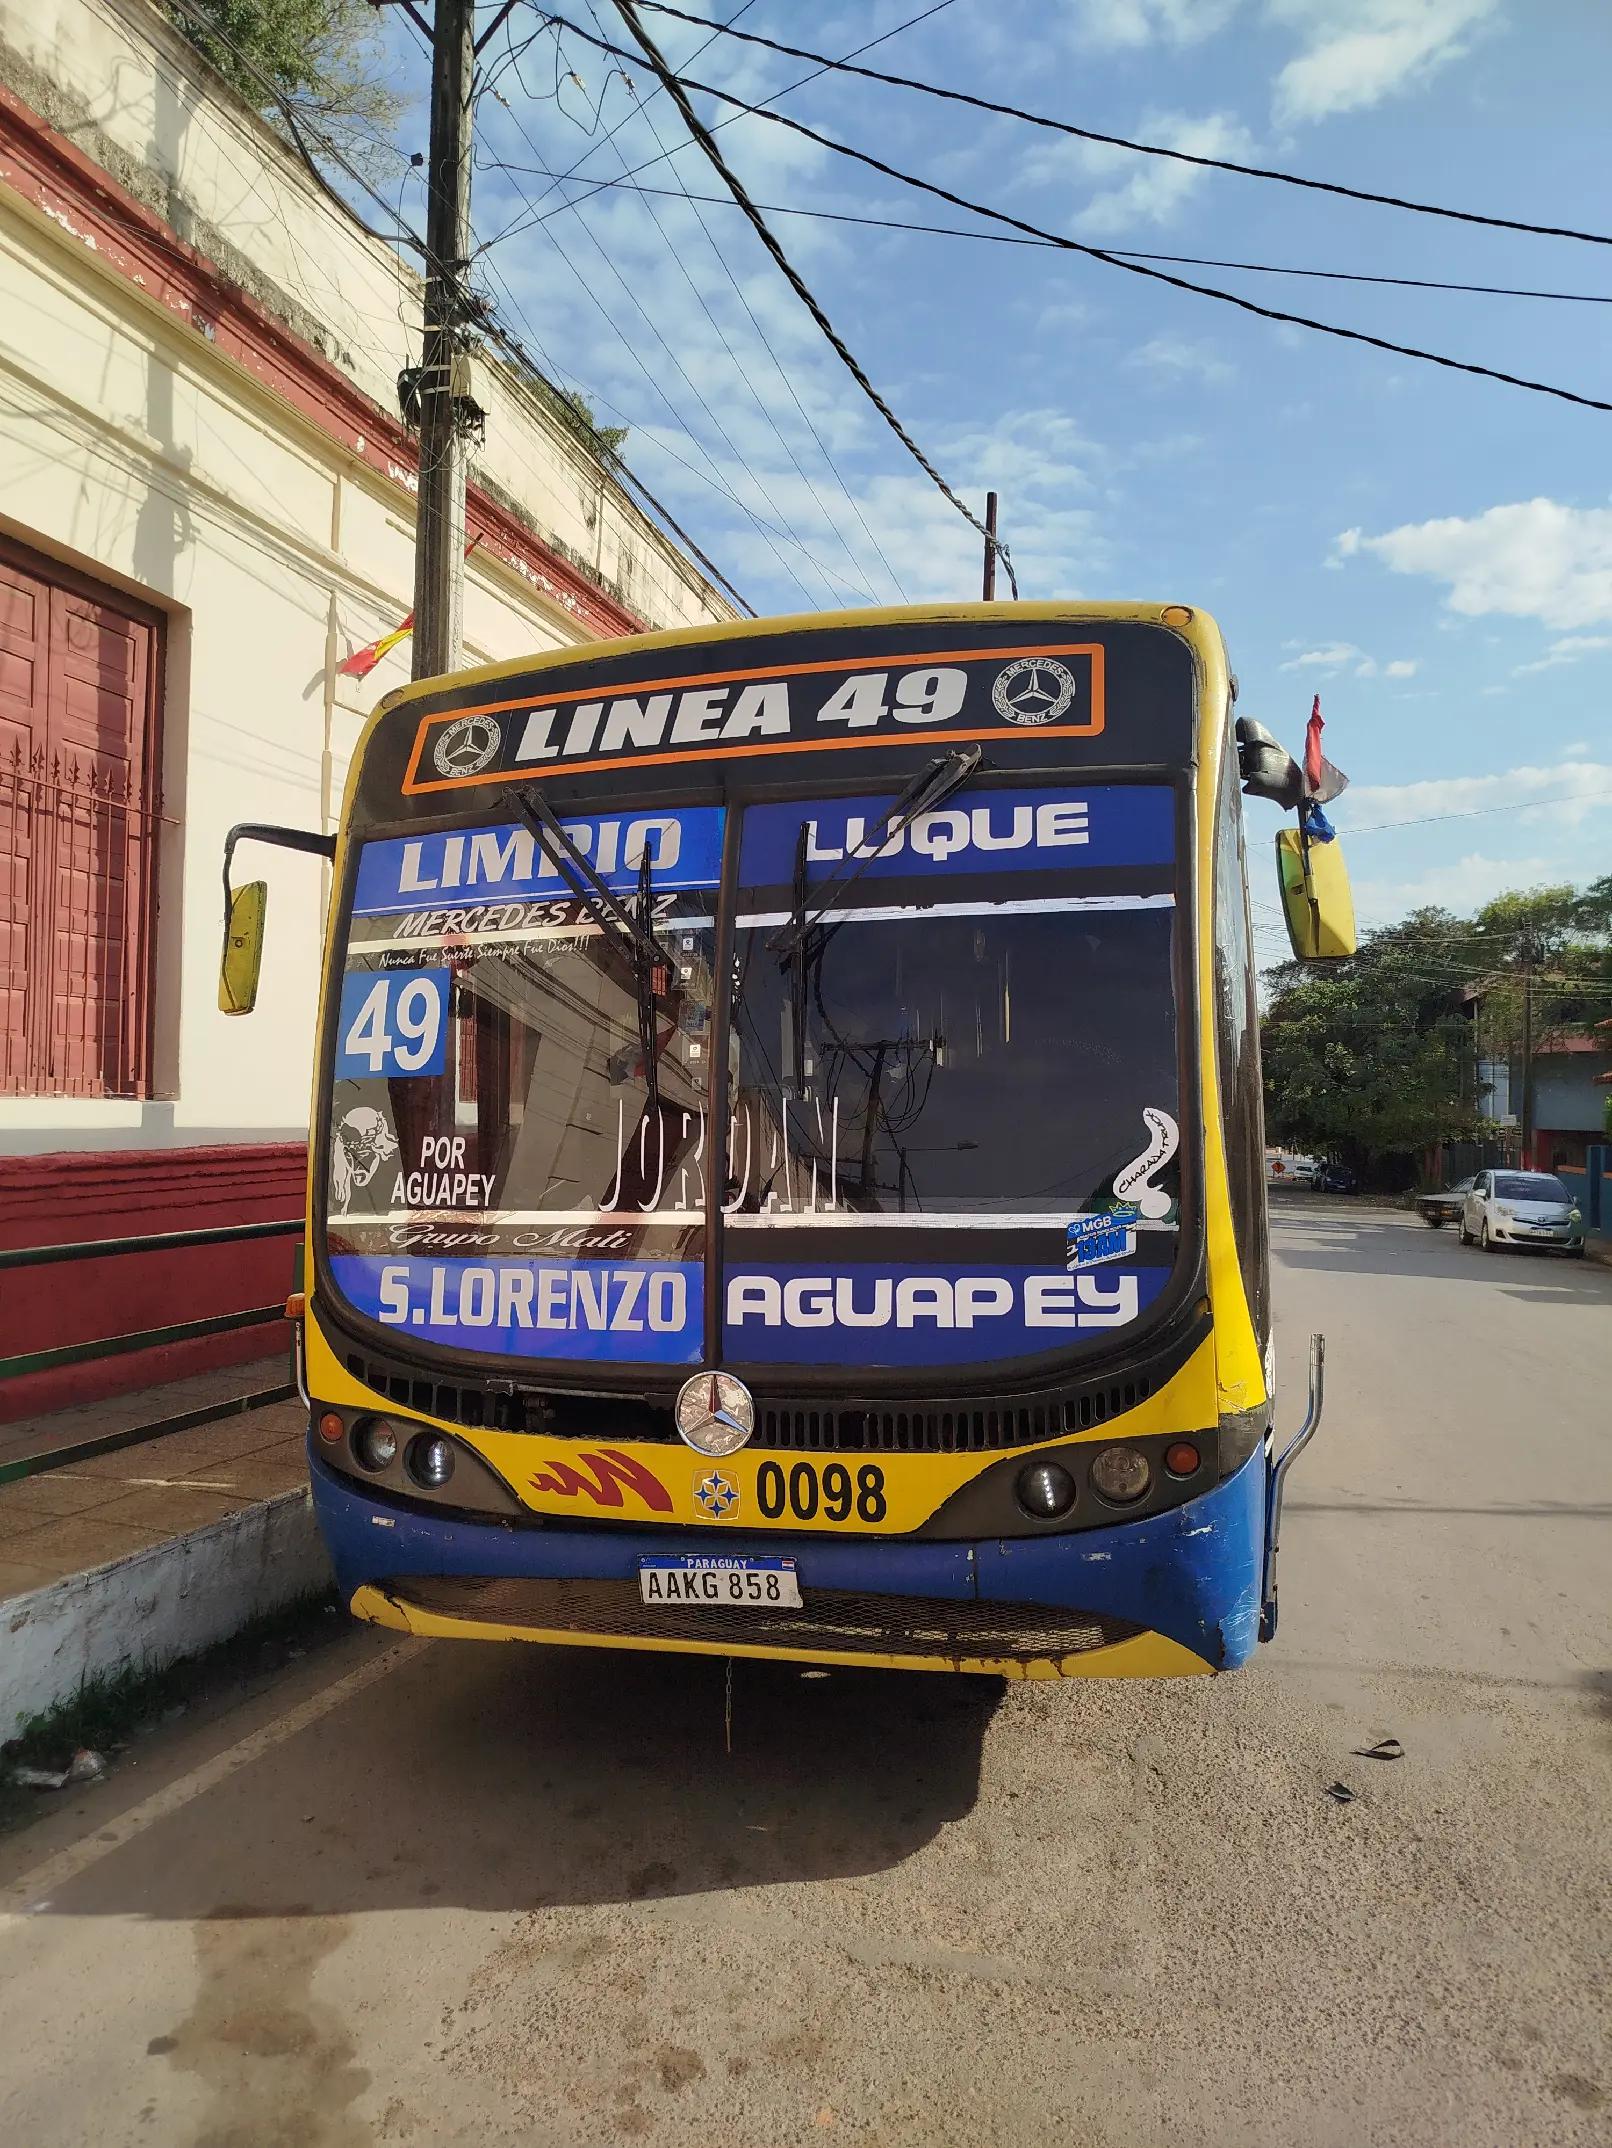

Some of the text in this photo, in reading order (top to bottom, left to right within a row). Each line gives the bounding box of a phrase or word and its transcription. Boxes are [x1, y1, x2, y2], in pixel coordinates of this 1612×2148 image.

[1005, 660, 1064, 677] MERCEDES
[448, 717, 495, 736] MERCEDES
[515, 668, 968, 762] LINEA 49
[1017, 713, 1048, 723] BENZ
[450, 765, 475, 776] BENZ
[805, 802, 1090, 861] LUQUE
[398, 818, 682, 893] LIMPIO
[393, 902, 572, 939] MERCEDES
[378, 953, 415, 969] Nunca
[419, 950, 438, 963] Fue
[477, 944, 520, 961] Siempre
[523, 940, 544, 953] Fue
[345, 978, 441, 1072] 49
[420, 1136, 466, 1169] POR
[390, 1172, 496, 1207] AGUAPEY
[389, 1224, 633, 1249] Grupo Mati
[1081, 1216, 1112, 1233] MGB
[378, 1266, 687, 1332] S.LORENZO
[756, 1460, 888, 1523] 0098
[687, 1558, 748, 1570] PARAGUAY
[648, 1571, 781, 1601] AAKG 858
